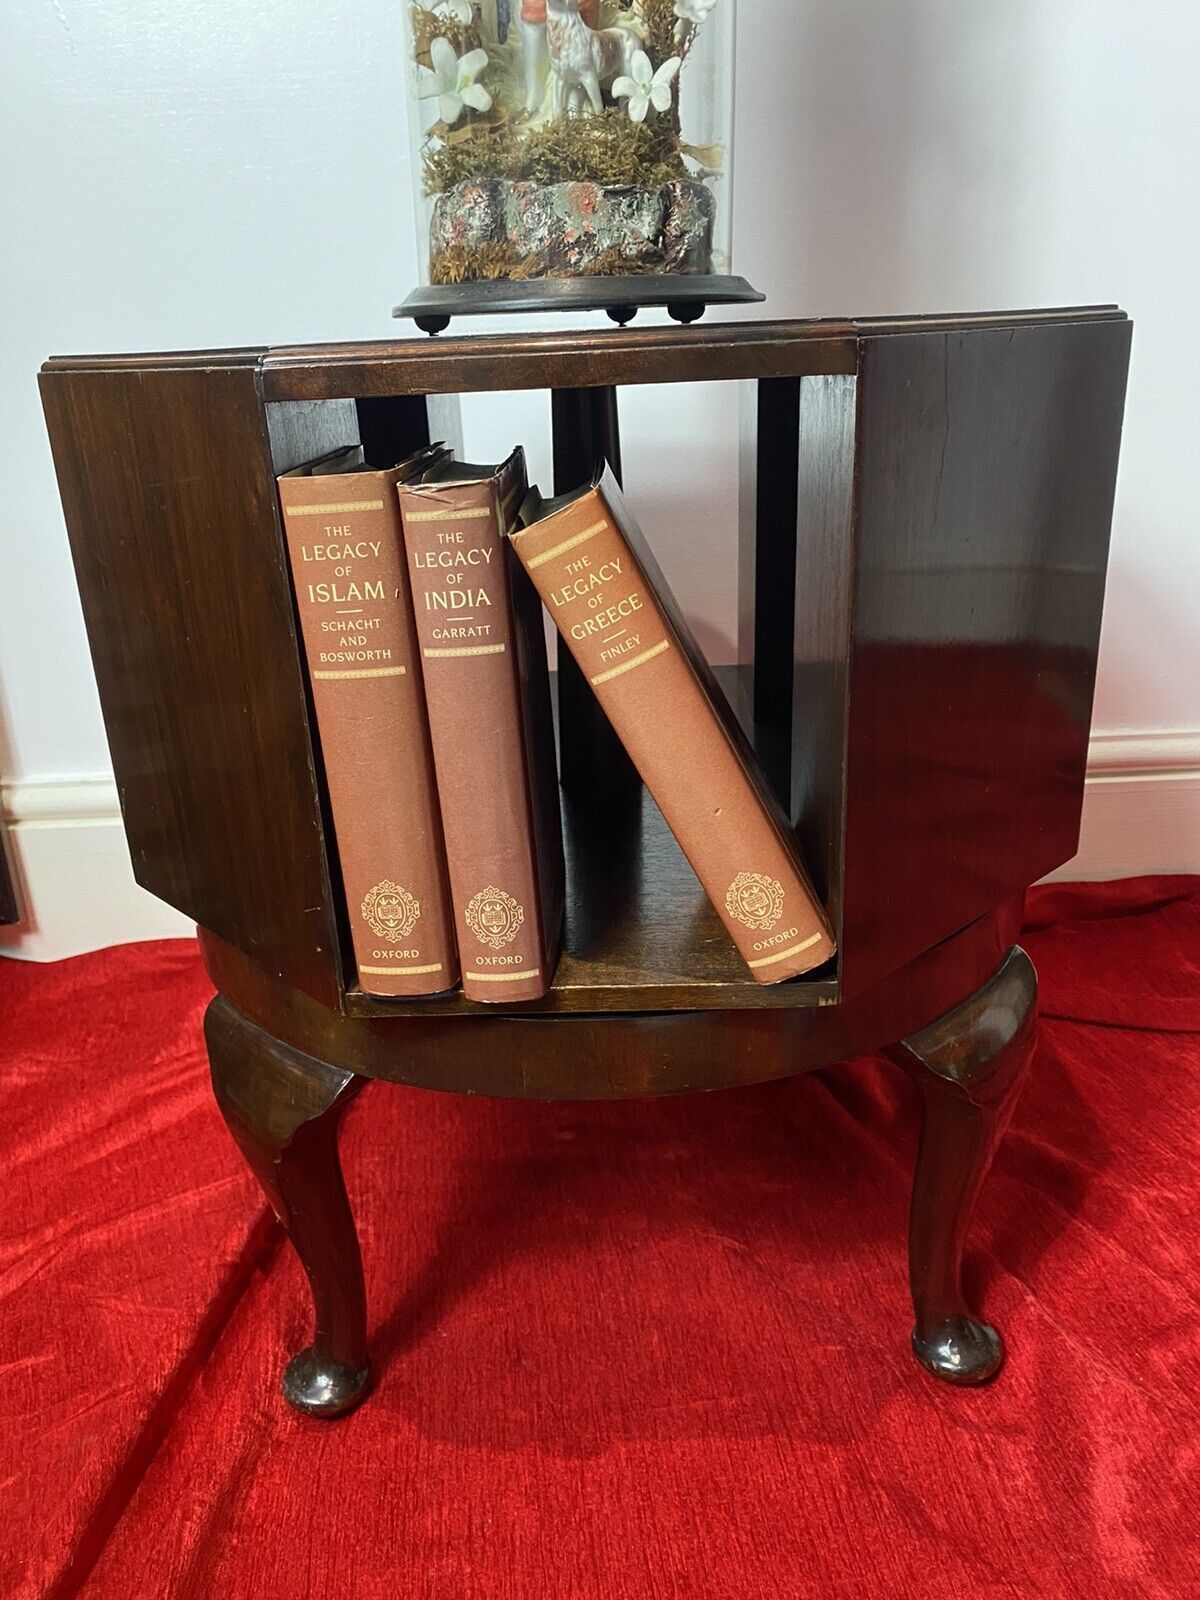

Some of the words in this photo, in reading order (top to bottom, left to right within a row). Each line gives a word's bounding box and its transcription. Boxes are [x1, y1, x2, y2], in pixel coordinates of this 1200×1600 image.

[325, 526, 352, 537] THE
[437, 532, 464, 544] THE
[301, 541, 381, 561] LEGACY
[414, 547, 493, 568] LEGACY
[334, 566, 352, 577] OF
[564, 555, 592, 575] THE
[446, 573, 464, 584] OF
[550, 557, 622, 607] LEGACY
[308, 581, 385, 603] ISLAM
[424, 588, 492, 610] INDIA
[587, 593, 603, 608] OF
[570, 593, 643, 640] GREECE
[321, 618, 381, 632] SCHACHT
[432, 625, 491, 639] GARRATT
[339, 636, 367, 647] AND
[600, 634, 640, 662] FINLEY
[319, 649, 392, 662] BOSWORTH
[753, 927, 799, 951] OXFORD
[372, 949, 420, 959] OXFORD
[475, 955, 523, 965] OXFORD
